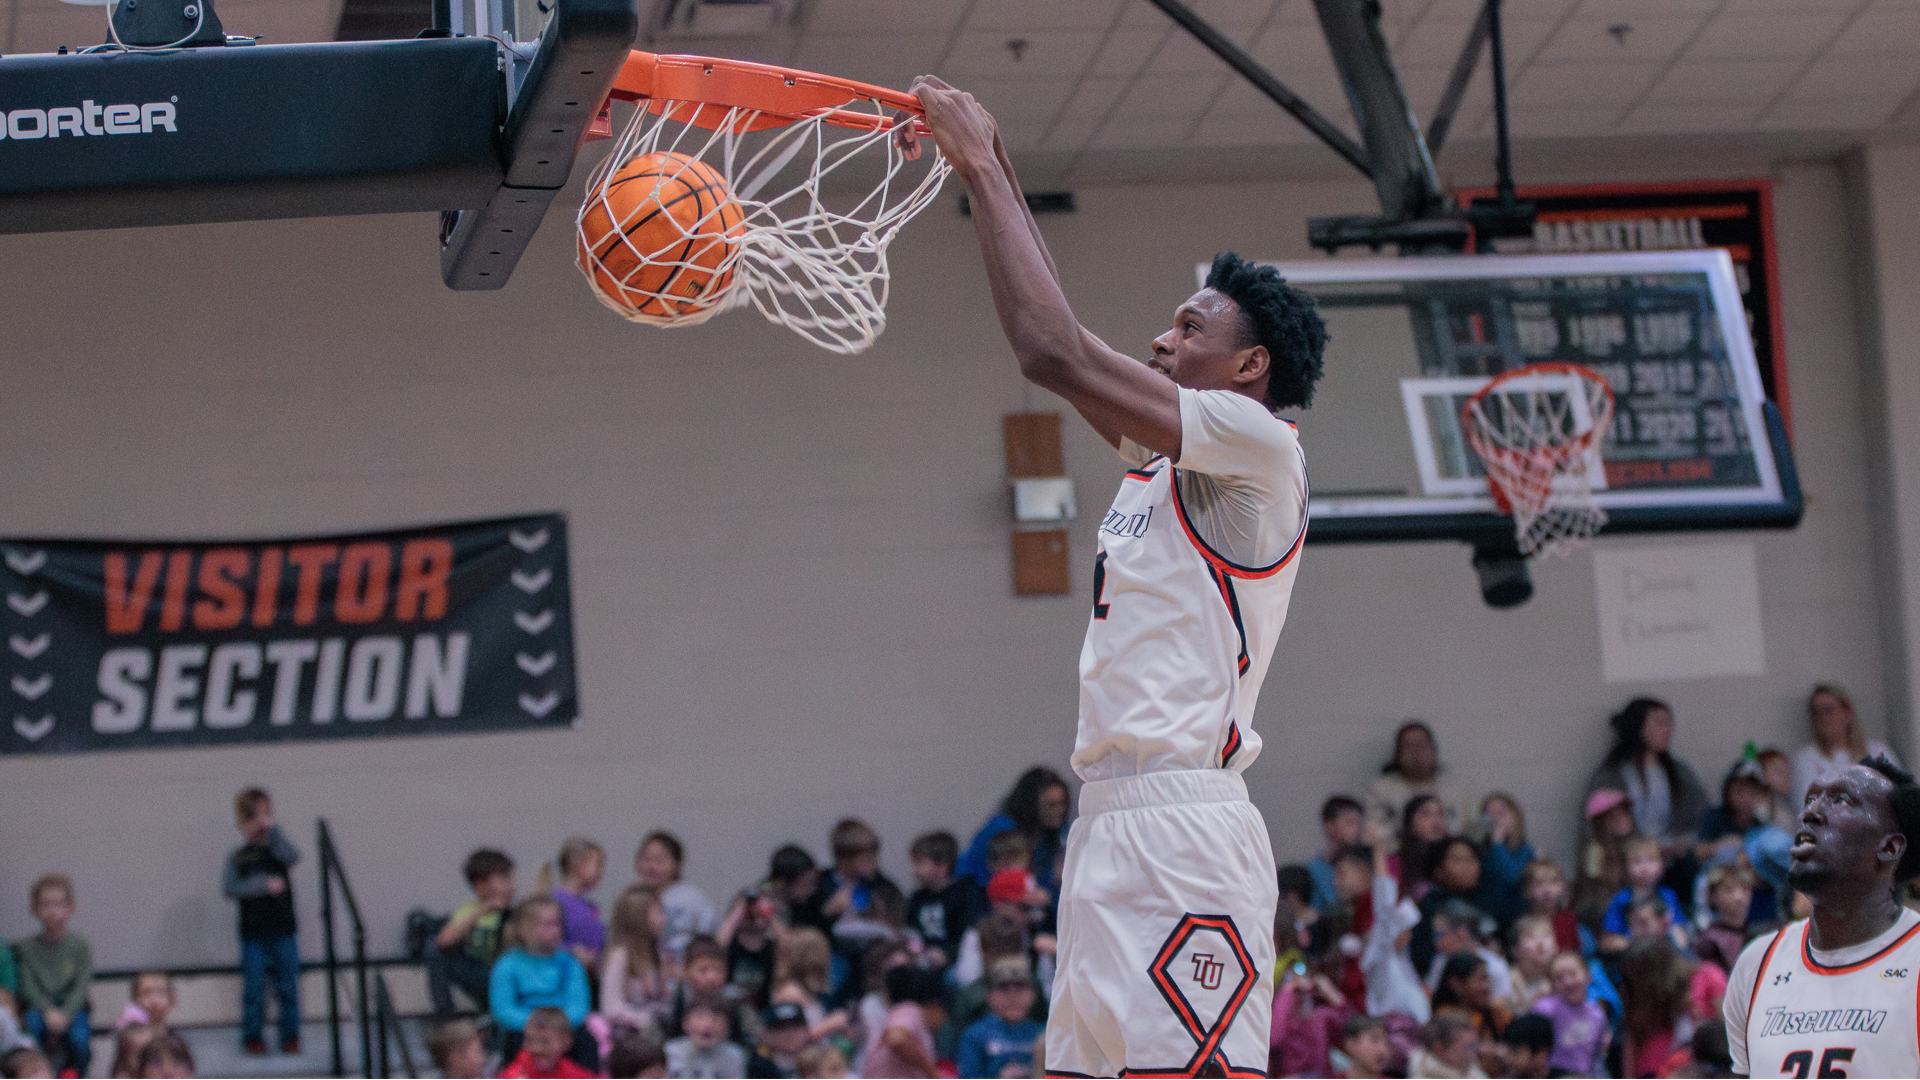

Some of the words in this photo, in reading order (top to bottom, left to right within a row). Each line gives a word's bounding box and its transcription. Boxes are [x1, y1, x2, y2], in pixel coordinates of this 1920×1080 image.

[0, 99, 178, 141] orter
[1534, 217, 1706, 250] BASKETBALL
[103, 538, 455, 634] VISITOR
[91, 631, 471, 734] SECTION
[1191, 952, 1225, 990] TU
[1883, 968, 1909, 979] SAC
[1760, 1006, 1888, 1038] TUSCULUM
